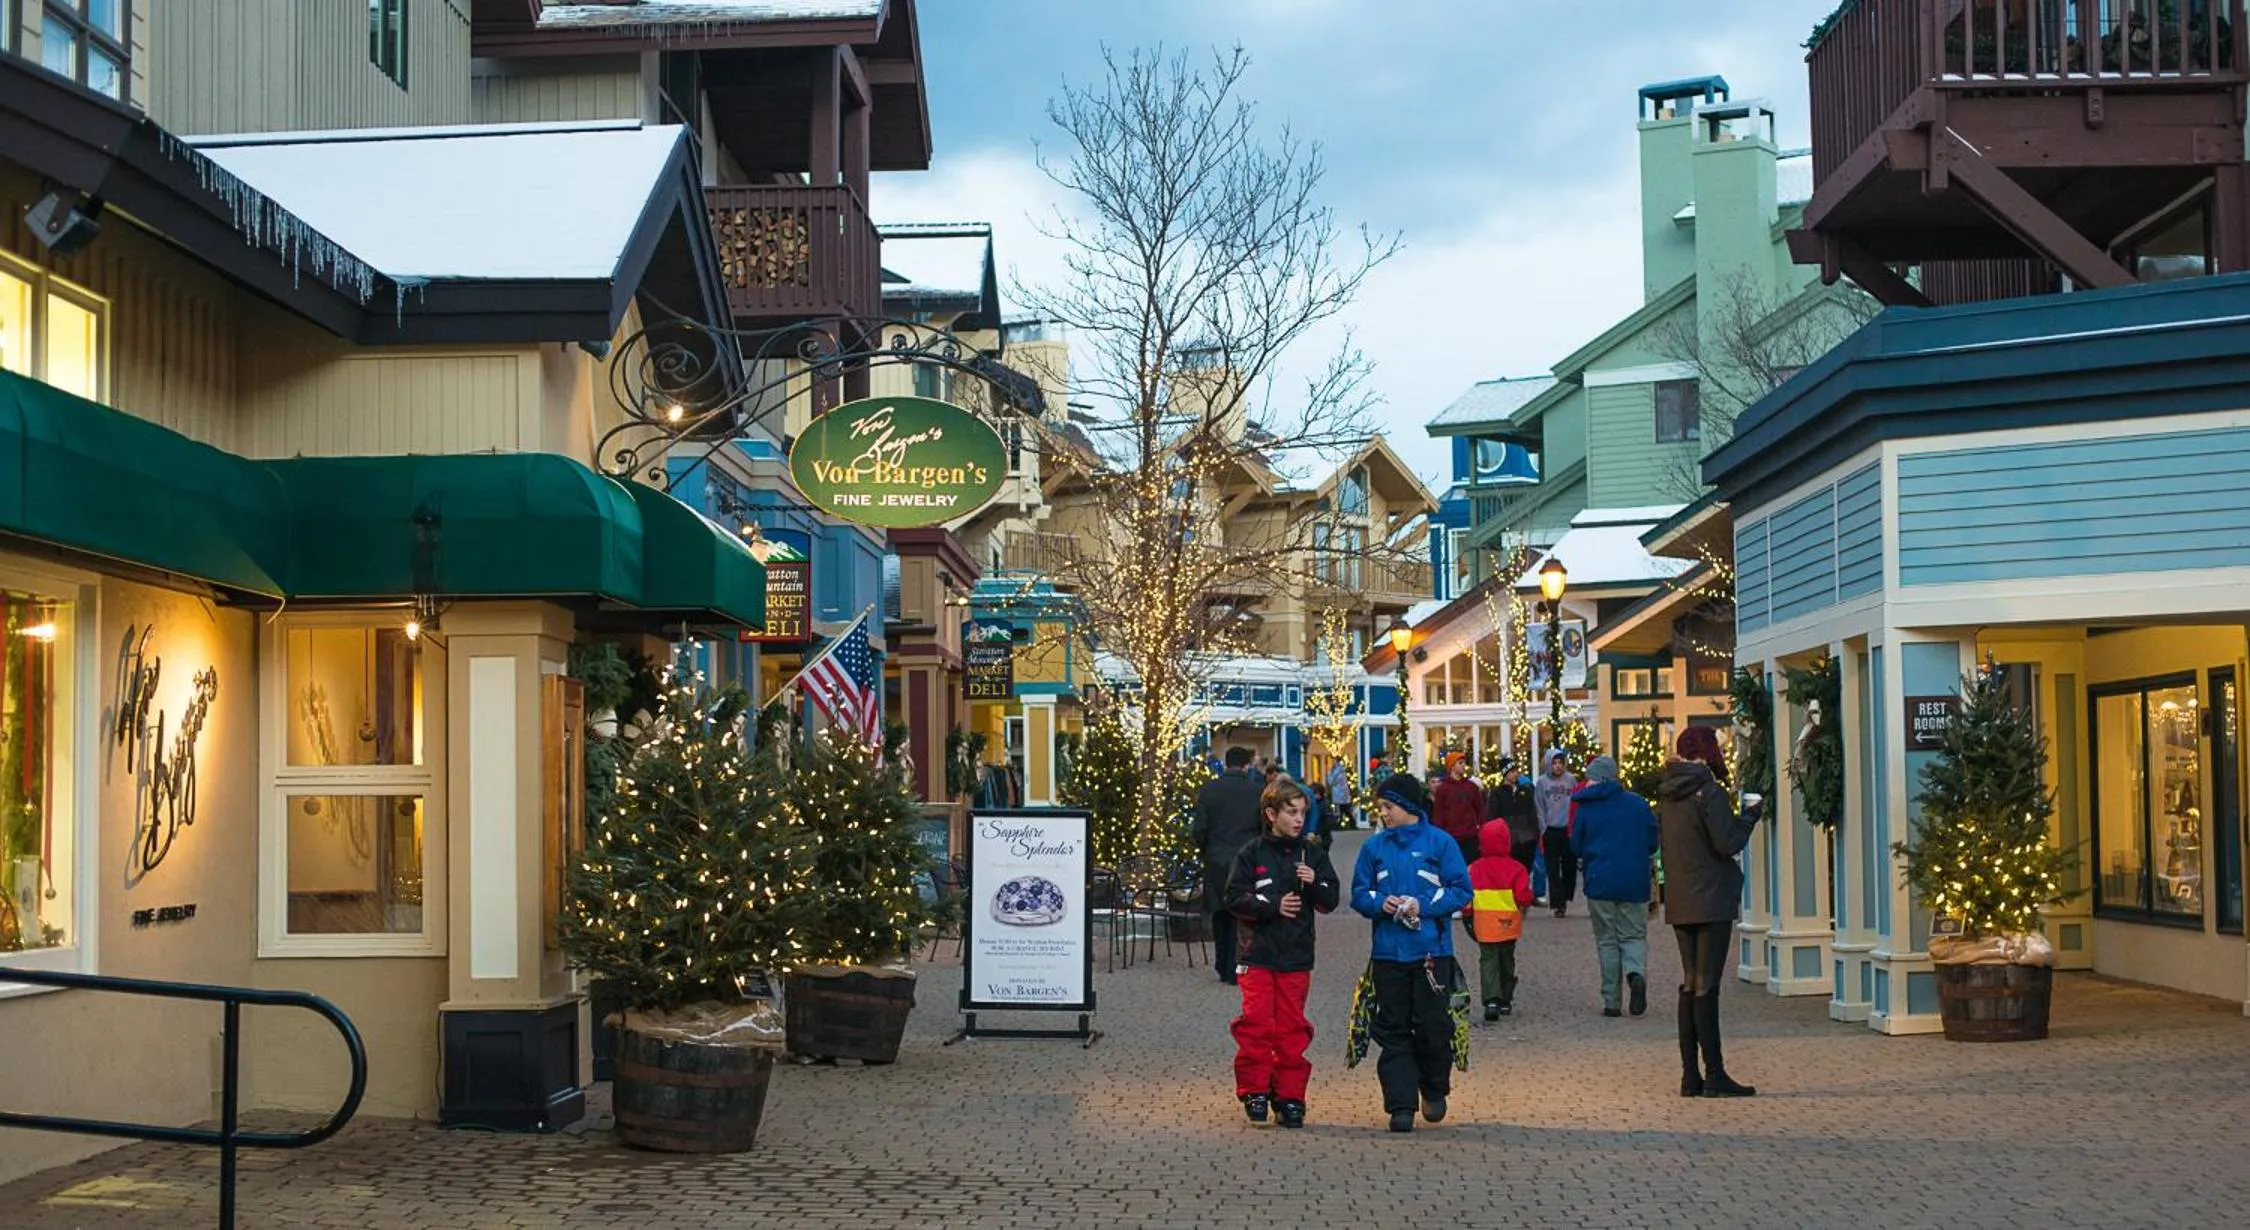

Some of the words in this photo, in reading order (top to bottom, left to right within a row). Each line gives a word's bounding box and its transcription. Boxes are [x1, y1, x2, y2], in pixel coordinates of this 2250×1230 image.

[811, 460, 860, 484] Von
[874, 460, 987, 489] Bargen's
[833, 495, 872, 506] FINE
[878, 495, 958, 507] JEWELRY
[969, 683, 1007, 696] DELI
[1919, 702, 1947, 716] REST
